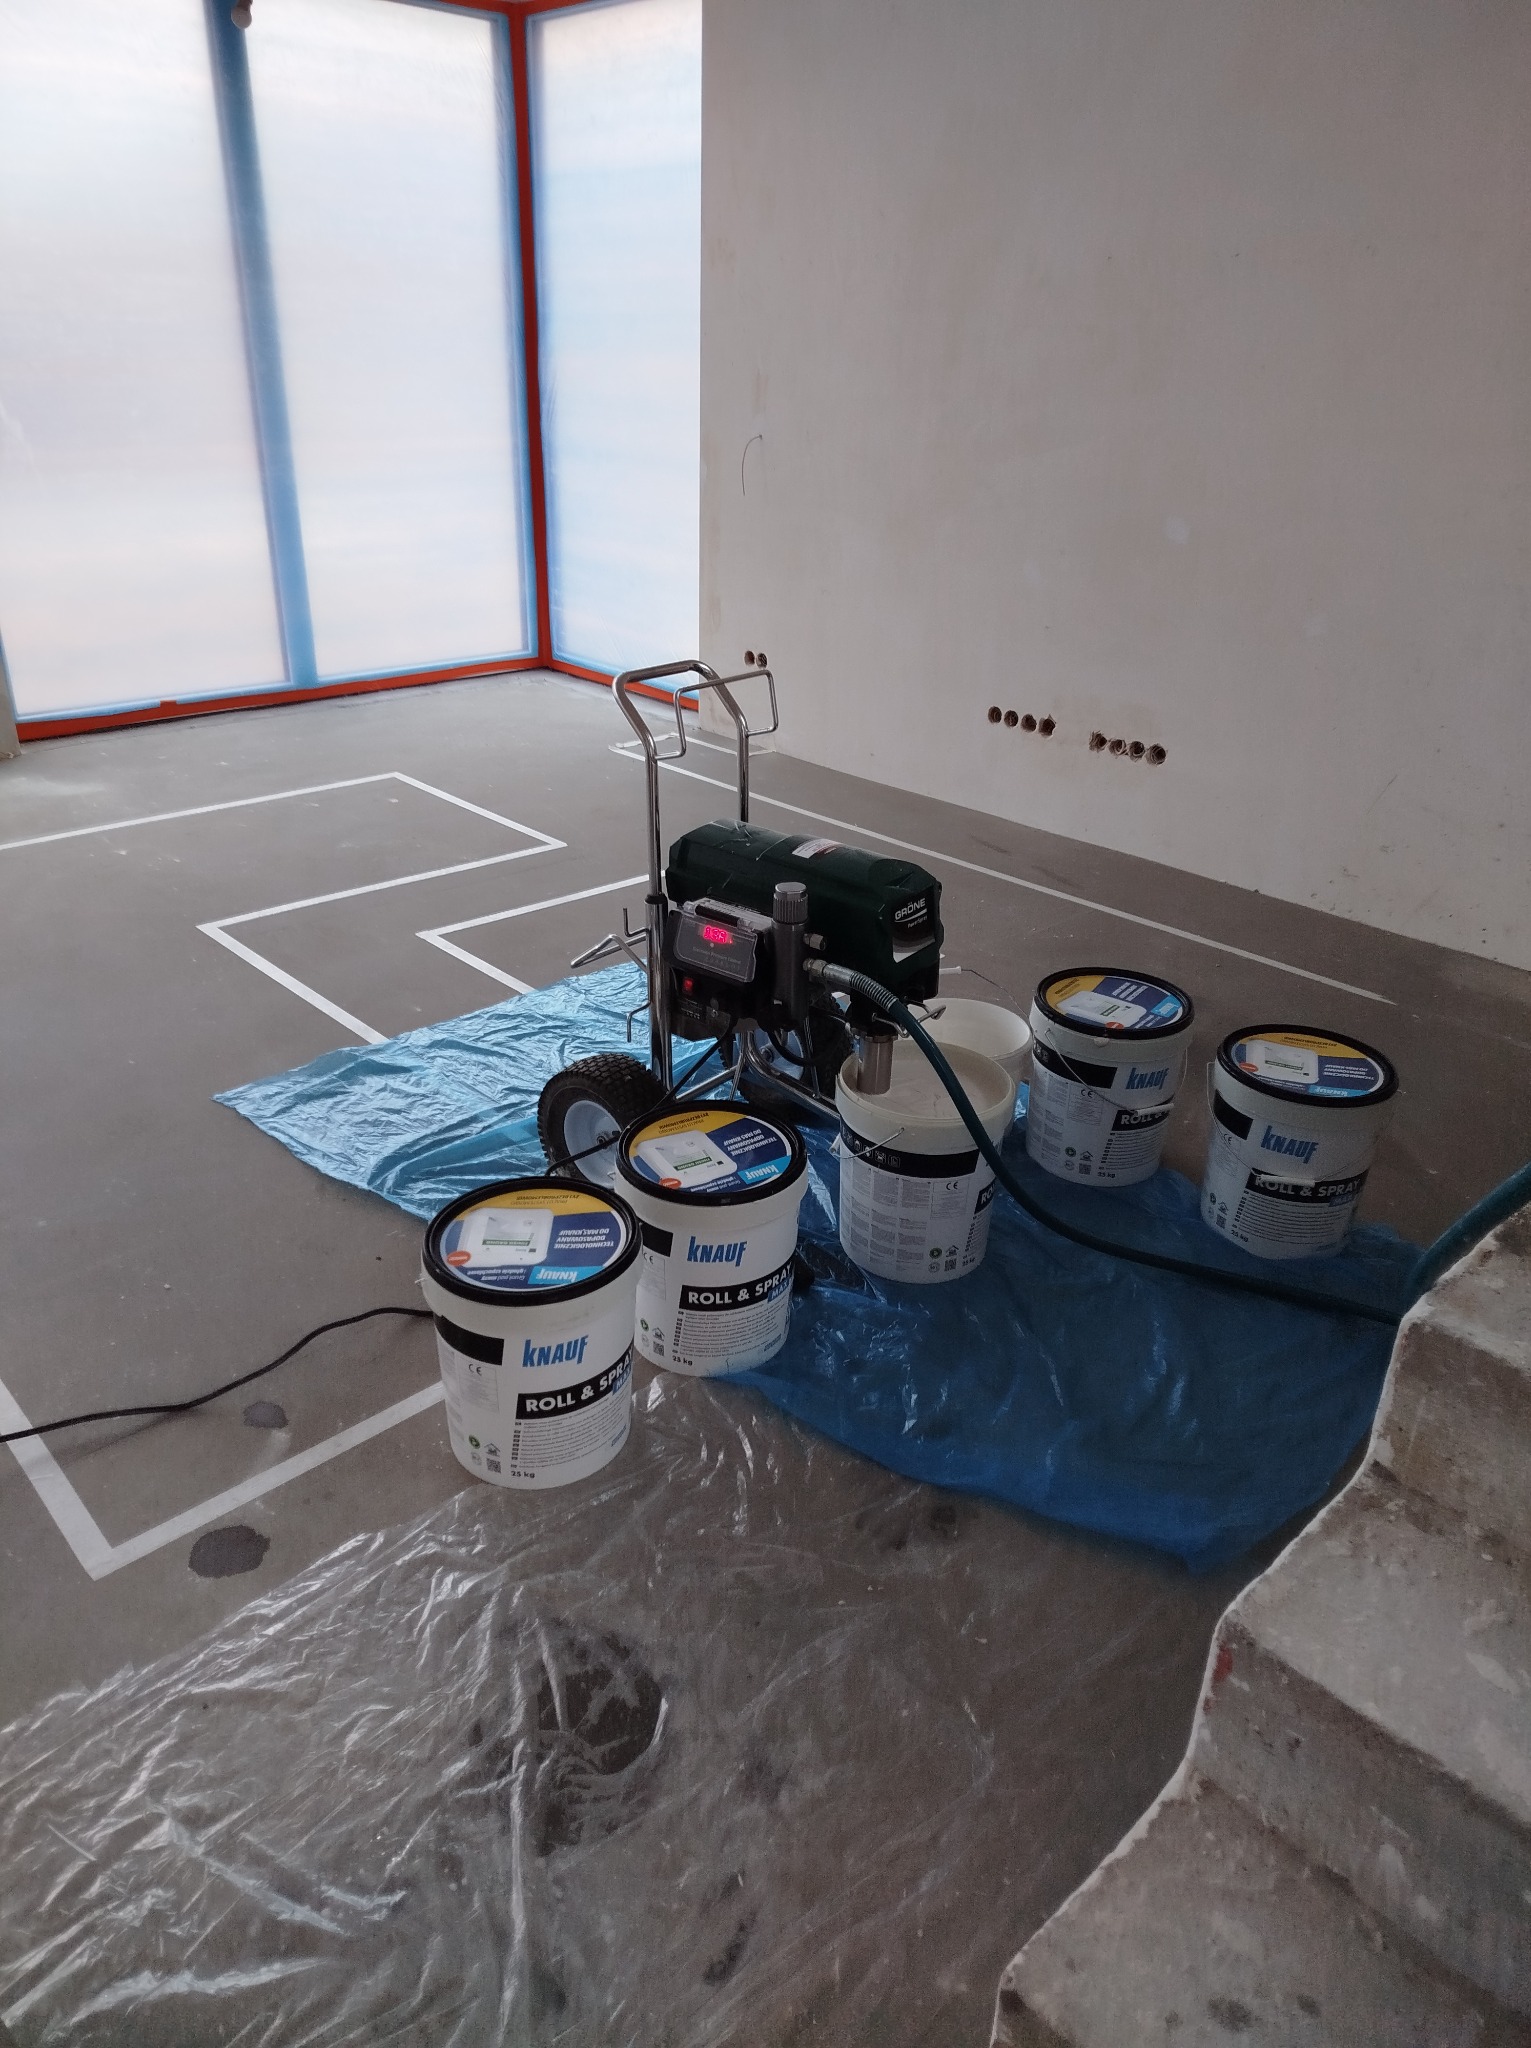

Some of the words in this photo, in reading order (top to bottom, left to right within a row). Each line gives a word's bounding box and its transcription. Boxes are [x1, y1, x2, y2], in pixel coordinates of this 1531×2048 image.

[894, 898, 926, 920] GRÖNE
[1126, 1068, 1170, 1090] KNAUF
[723, 1136, 741, 1146] KNAUF
[1260, 1125, 1319, 1164] KNAUF
[744, 1164, 778, 1179] KNAUF
[1318, 1178, 1361, 1197] SPRAY
[686, 1236, 748, 1268] KNAUF
[536, 1268, 578, 1282] KNAUF
[688, 1292, 732, 1305] ROLL
[737, 1288, 750, 1302] &
[754, 1261, 793, 1297] SPRAY
[522, 1334, 589, 1368] KNAUF
[672, 1355, 682, 1364] 25
[683, 1356, 693, 1366] kg
[525, 1392, 576, 1412] ROLL
[581, 1386, 594, 1400] &
[510, 1470, 522, 1478] 25
[524, 1470, 536, 1479] kg
